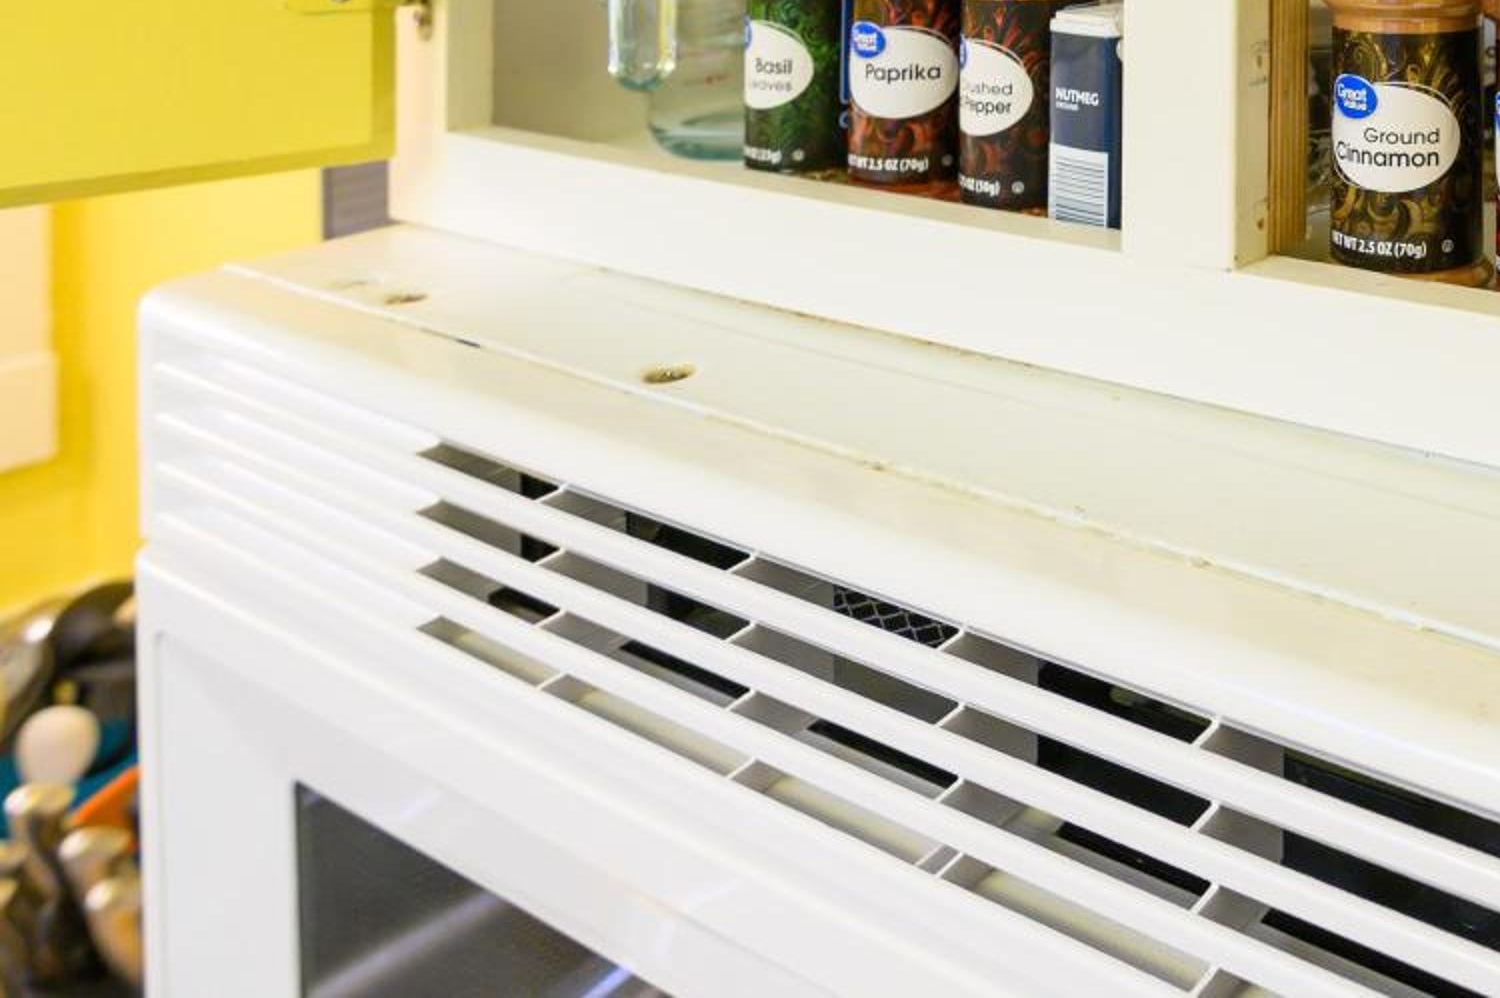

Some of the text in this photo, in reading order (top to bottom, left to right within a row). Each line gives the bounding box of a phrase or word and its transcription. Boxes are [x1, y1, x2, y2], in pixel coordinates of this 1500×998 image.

[755, 57, 793, 75] Basil
[865, 62, 942, 85] Paprika
[751, 81, 793, 93] eaves
[1055, 86, 1100, 107] NUTMEG
[1337, 83, 1368, 103] Great
[1363, 127, 1440, 145] Ground
[1337, 141, 1440, 168] Cinnamon
[884, 158, 899, 171] OZ
[900, 156, 929, 174] (70g)
[1344, 233, 1357, 251] WT
[1357, 239, 1376, 255] 2.5
[1377, 241, 1393, 257] OZ
[1394, 241, 1427, 260] (70g)
